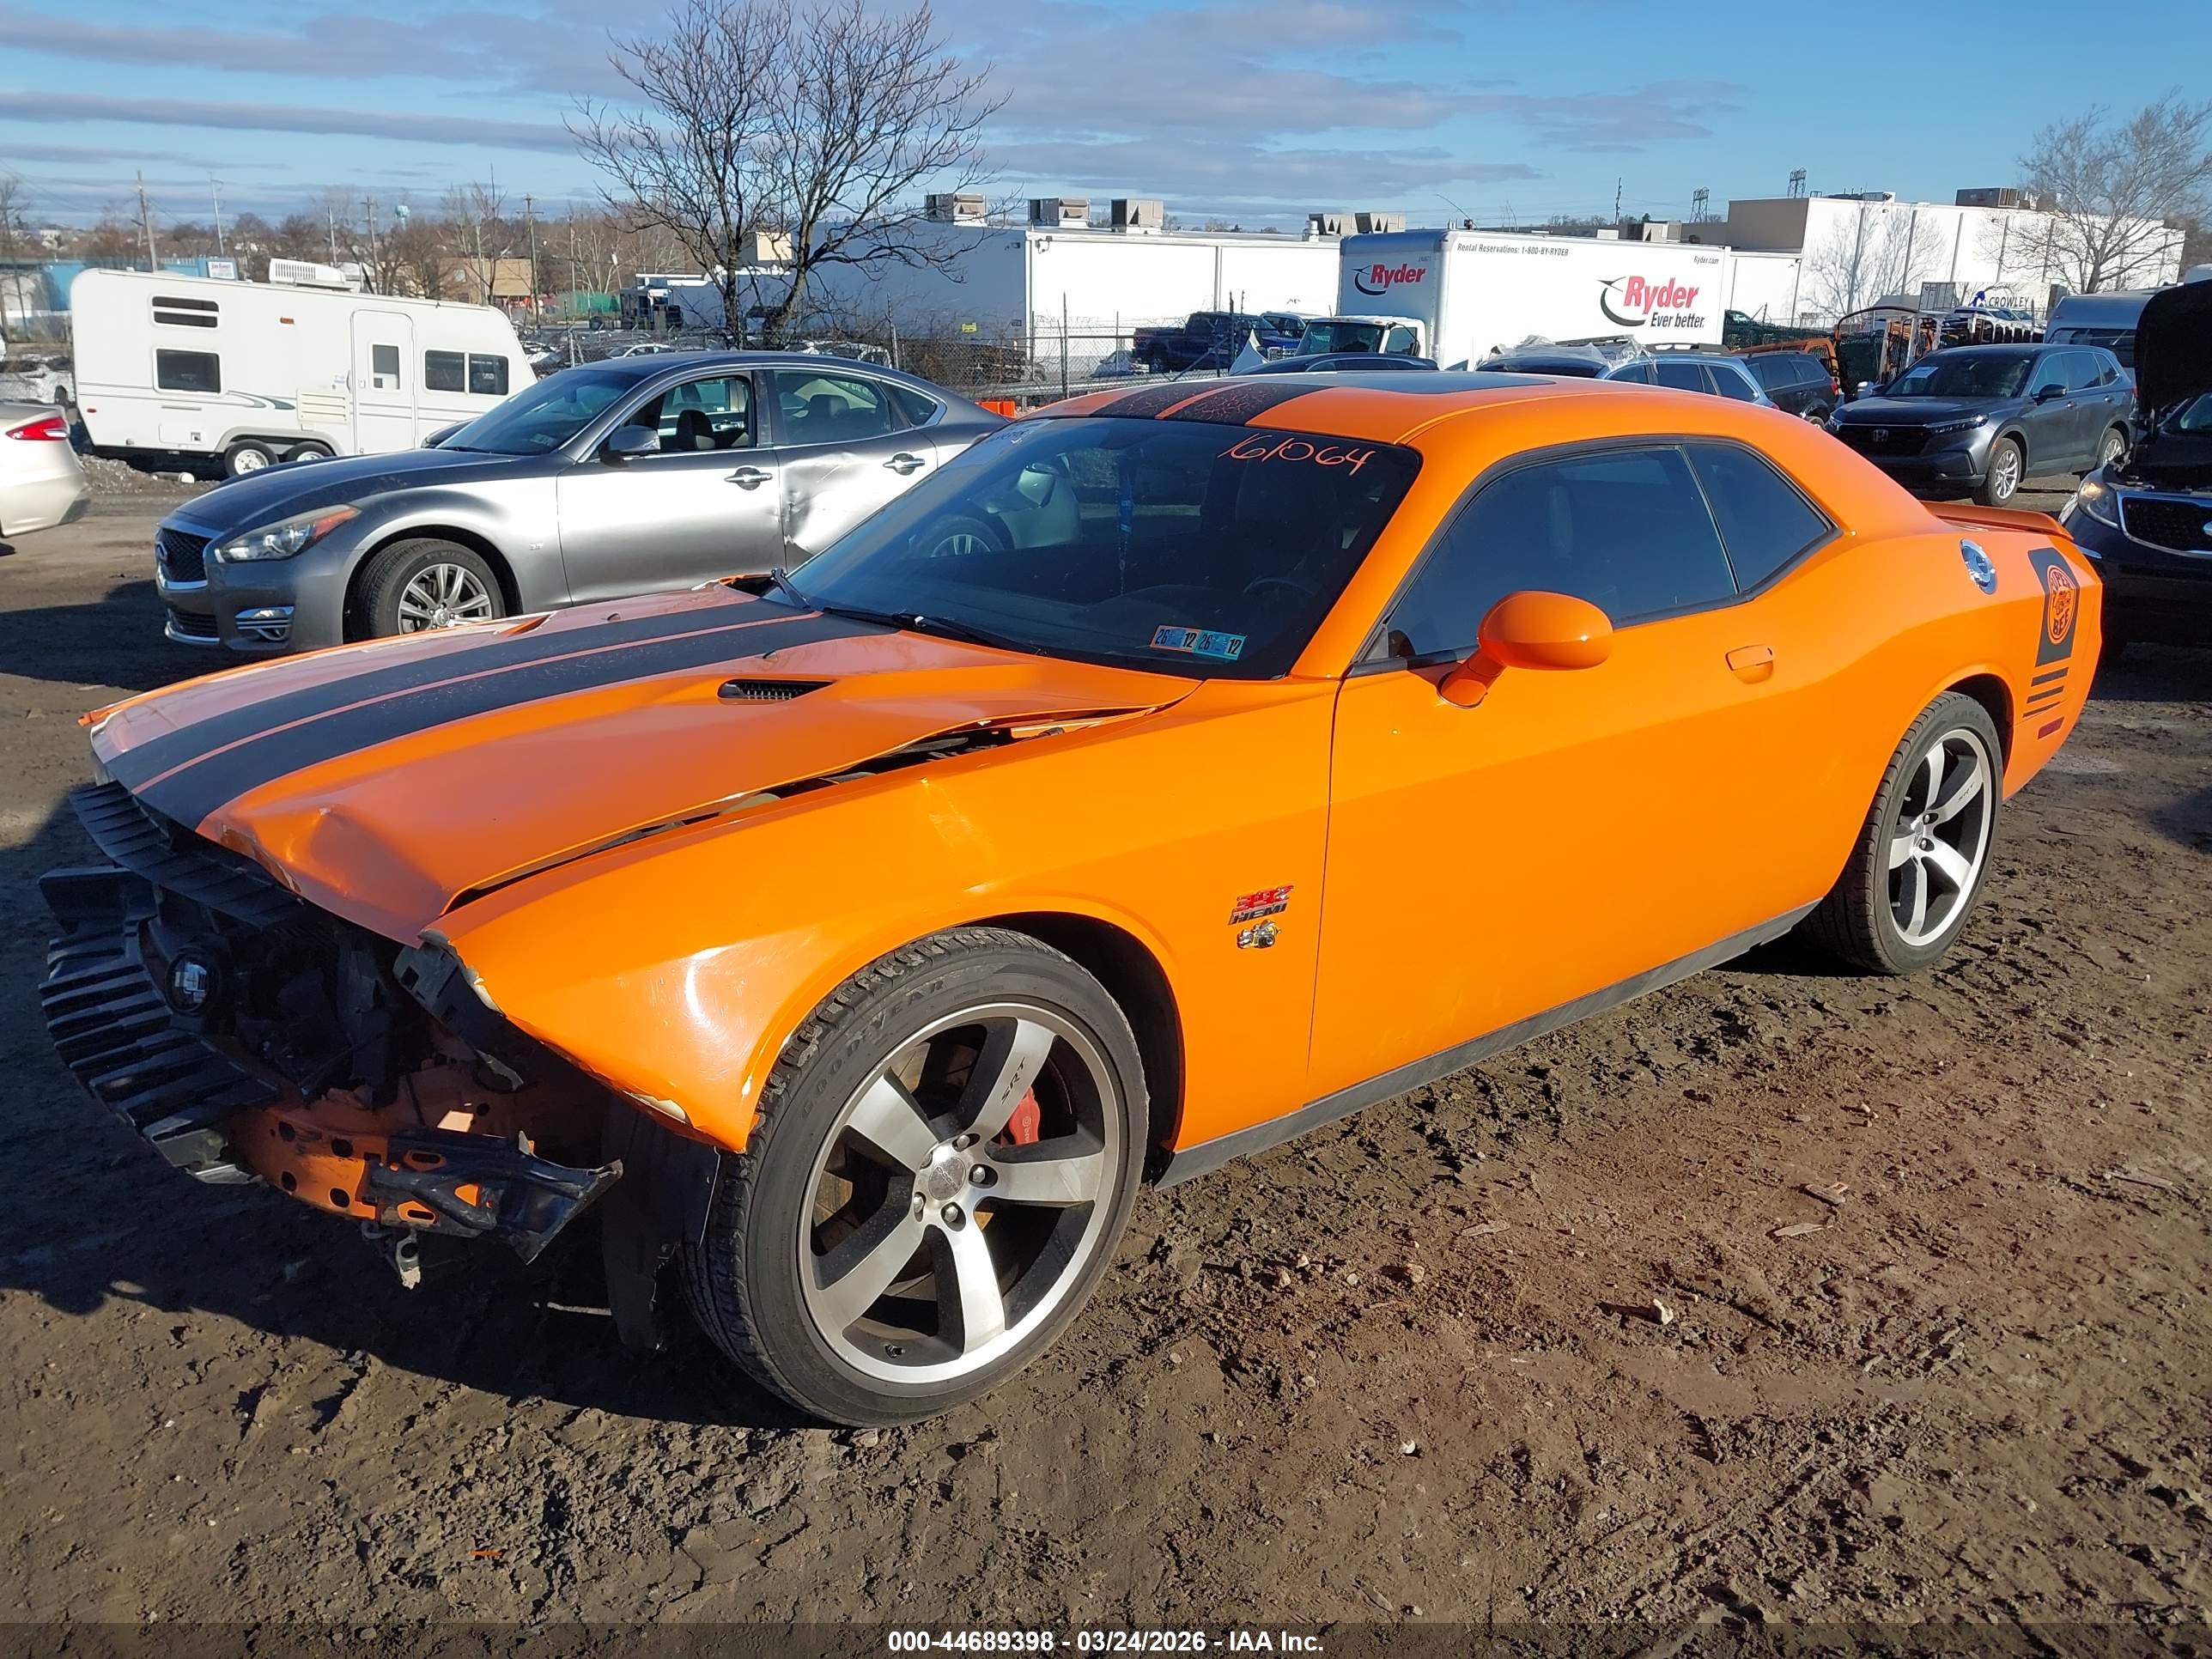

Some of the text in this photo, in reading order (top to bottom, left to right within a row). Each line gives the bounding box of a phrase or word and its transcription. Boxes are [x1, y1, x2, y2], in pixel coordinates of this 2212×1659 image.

[1457, 242, 1569, 257] Rental Reservations: 1-800-BY-RYDER
[1693, 256, 1719, 264] Ryder.com
[1370, 263, 1426, 289] Ryder
[1623, 275, 1700, 315] Ryder
[1988, 295, 2029, 307] CROWLEY
[1650, 312, 1705, 328] Ever better.
[2053, 608, 2070, 636] BEE
[1182, 632, 1198, 648] 12
[1226, 638, 1243, 655] 12
[1228, 901, 1287, 926] HEMI
[803, 979, 945, 1115] GOODYEAR
[1001, 1056, 1025, 1105] SRT
